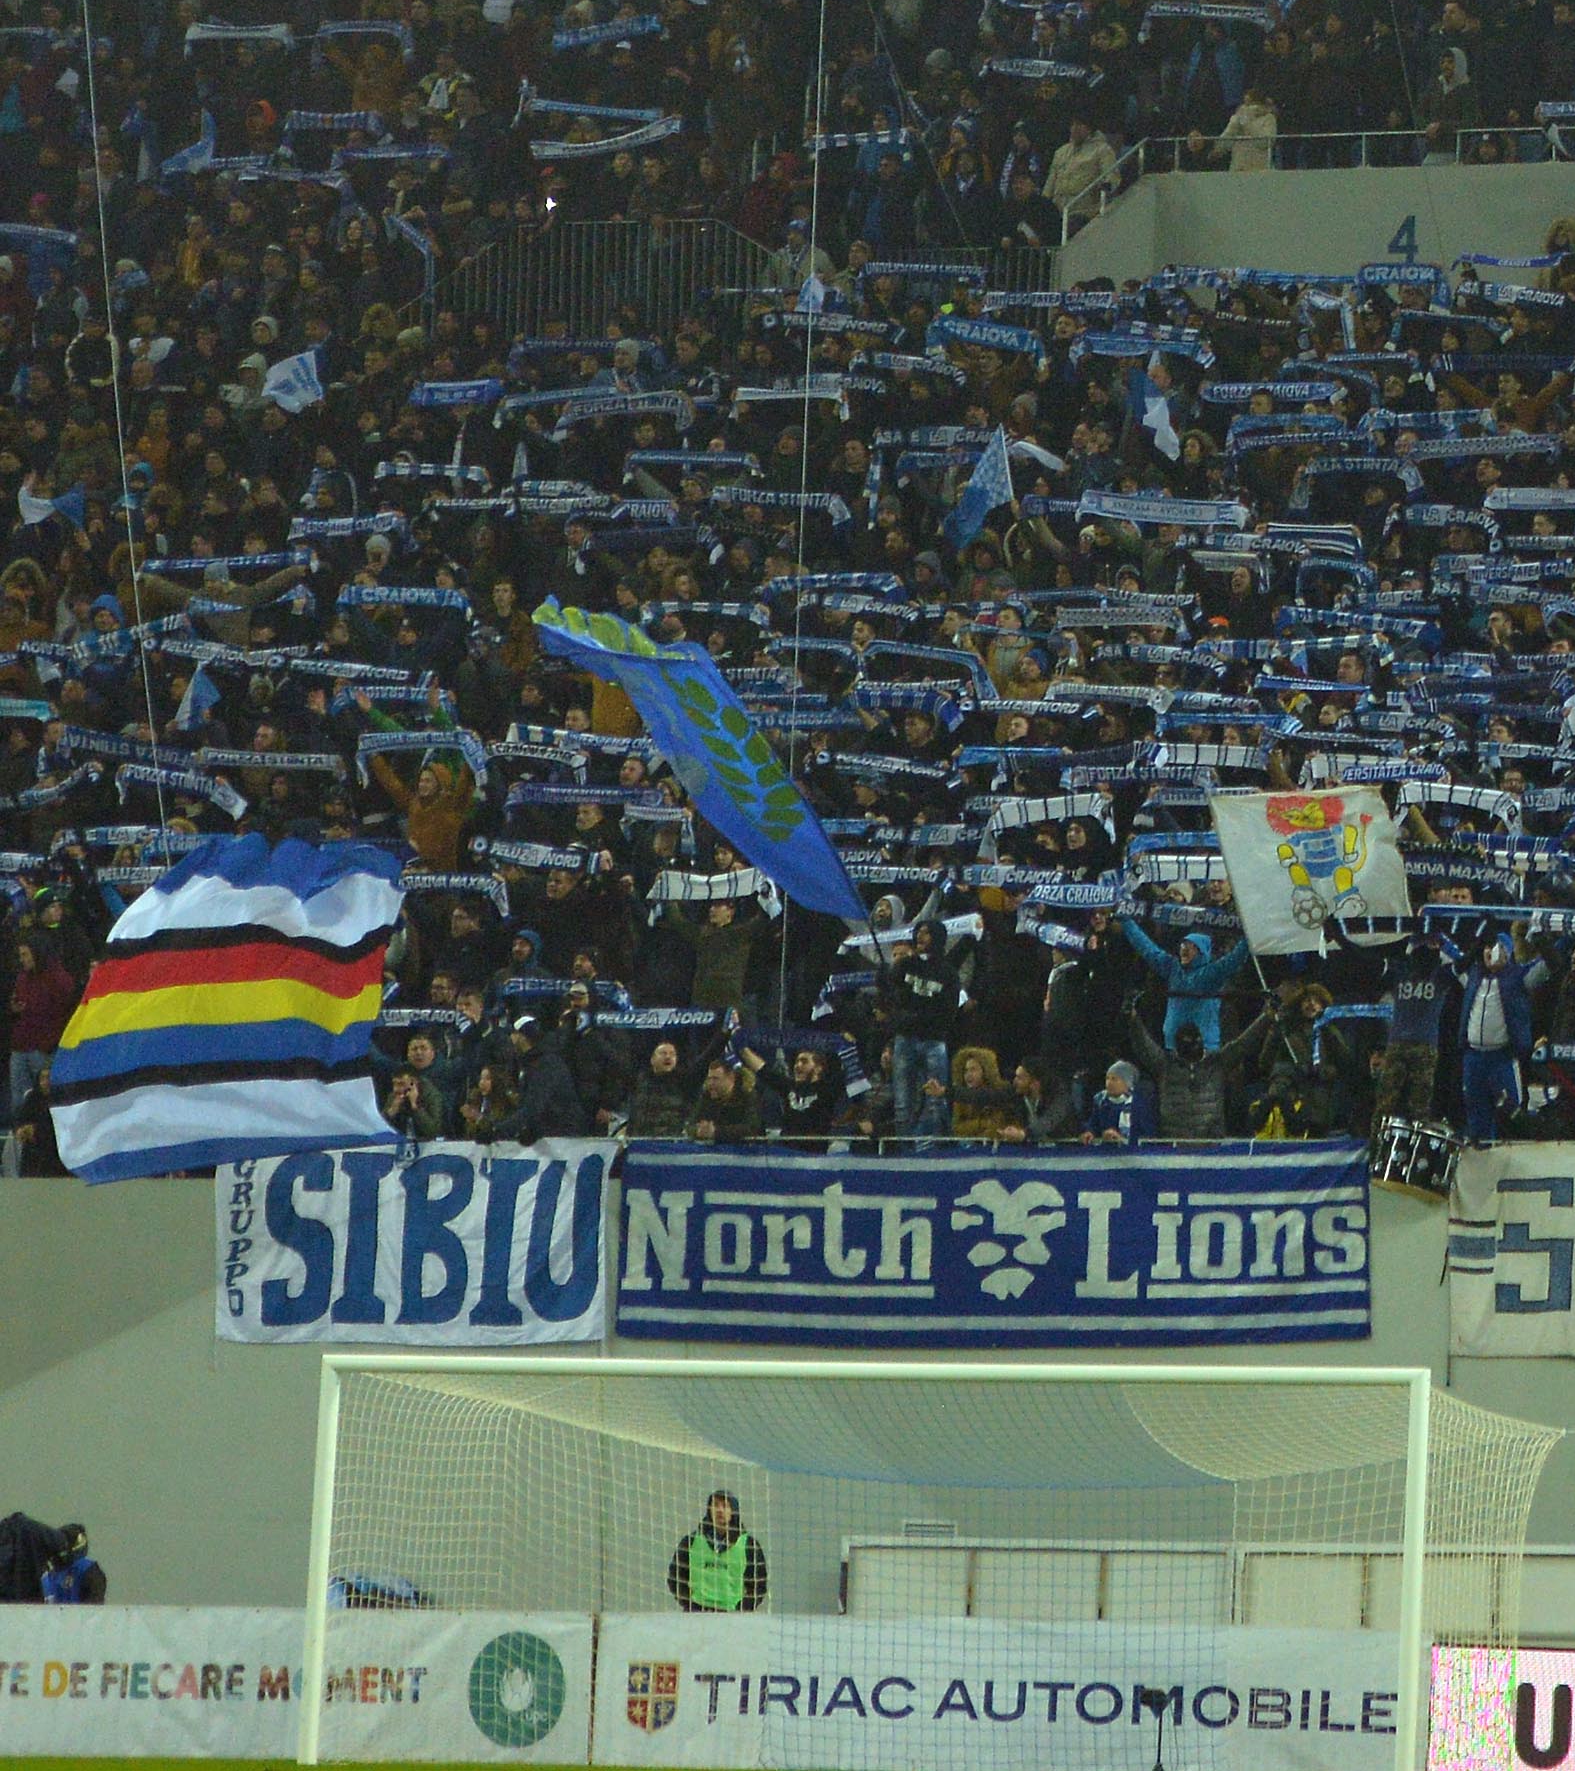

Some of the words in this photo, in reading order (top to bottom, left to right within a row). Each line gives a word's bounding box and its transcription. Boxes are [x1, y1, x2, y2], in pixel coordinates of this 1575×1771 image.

[1363, 264, 1436, 281] CRAIOVA
[488, 841, 538, 865] PELUZA
[541, 847, 582, 868] NORD
[1398, 982, 1435, 1001] 1948
[596, 1009, 658, 1026] PELUZA
[665, 1009, 716, 1026] NORD
[260, 1150, 605, 1328] SIBIU
[622, 1182, 933, 1291] North
[1074, 1190, 1368, 1299] Lions
[43, 1662, 91, 1699] DE
[101, 1662, 245, 1701] FIECARE
[694, 1673, 917, 1725] TIRIAC
[933, 1680, 1398, 1735] AUTOMOBILE
